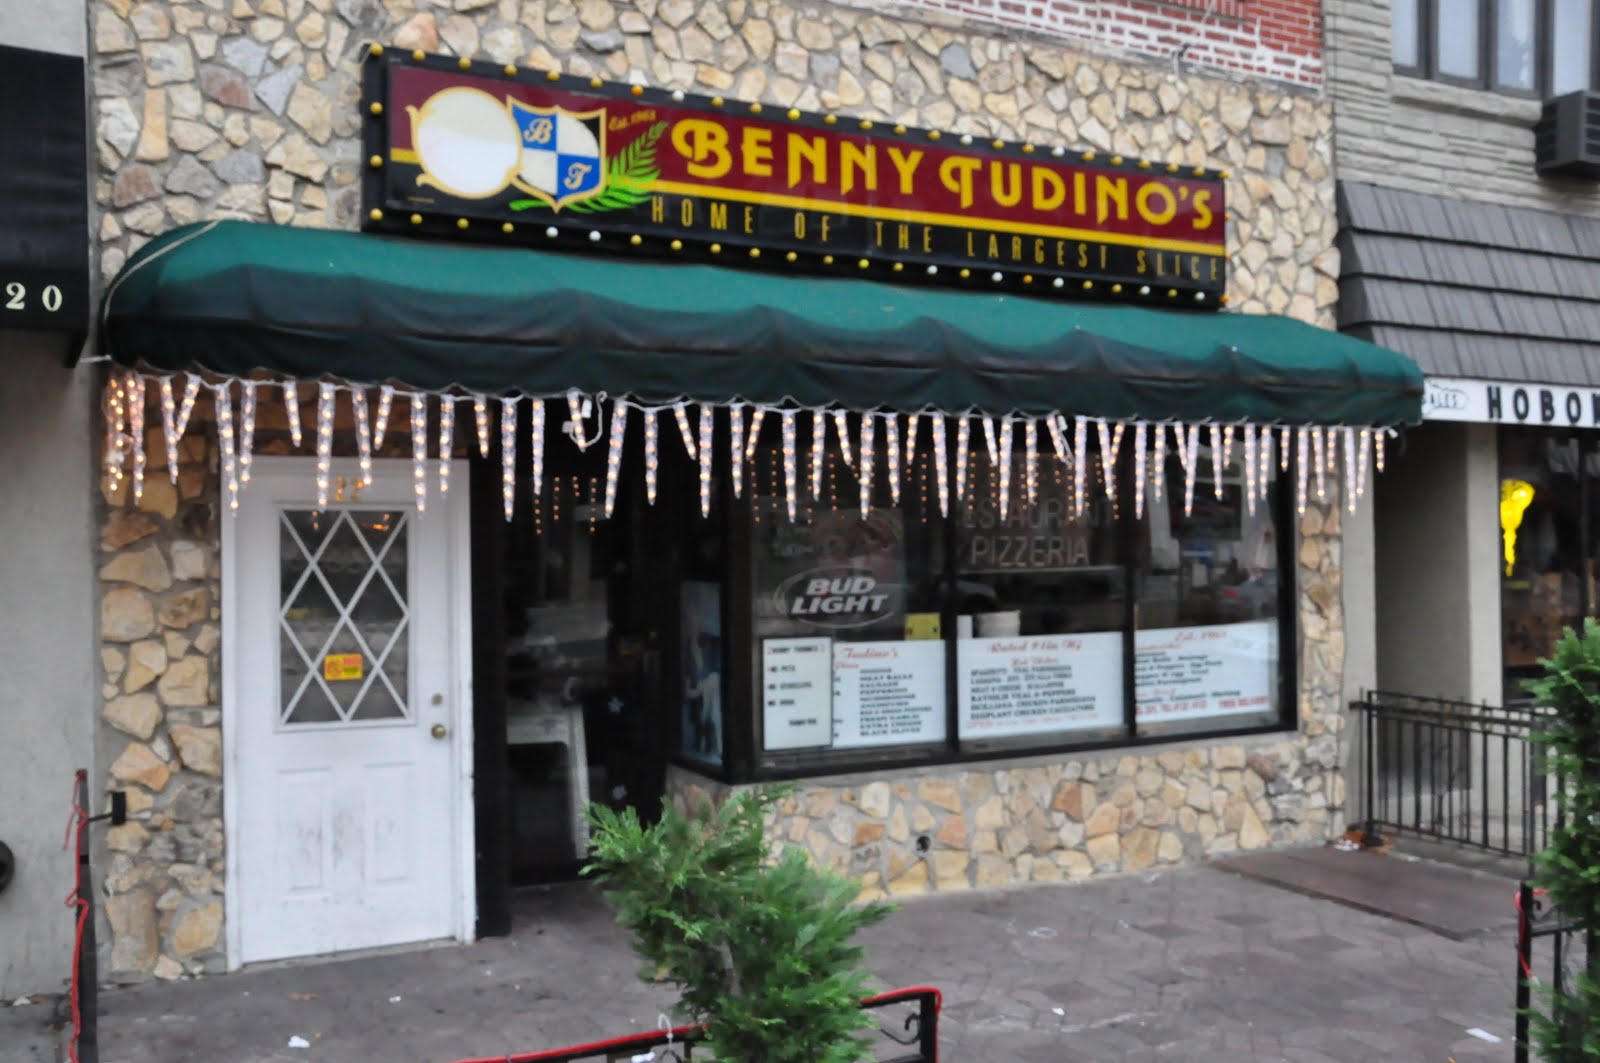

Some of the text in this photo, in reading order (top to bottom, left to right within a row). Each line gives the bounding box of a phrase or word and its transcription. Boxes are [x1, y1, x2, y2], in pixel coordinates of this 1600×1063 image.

[671, 118, 1213, 229] BENNY TUDINO'S
[652, 196, 1219, 281] HOME OF THE LARGEST SLICE
[6, 282, 63, 312] 20
[970, 535, 1090, 567] PIZZERIA
[806, 577, 876, 596] BUD
[791, 595, 888, 615] LIGHT
